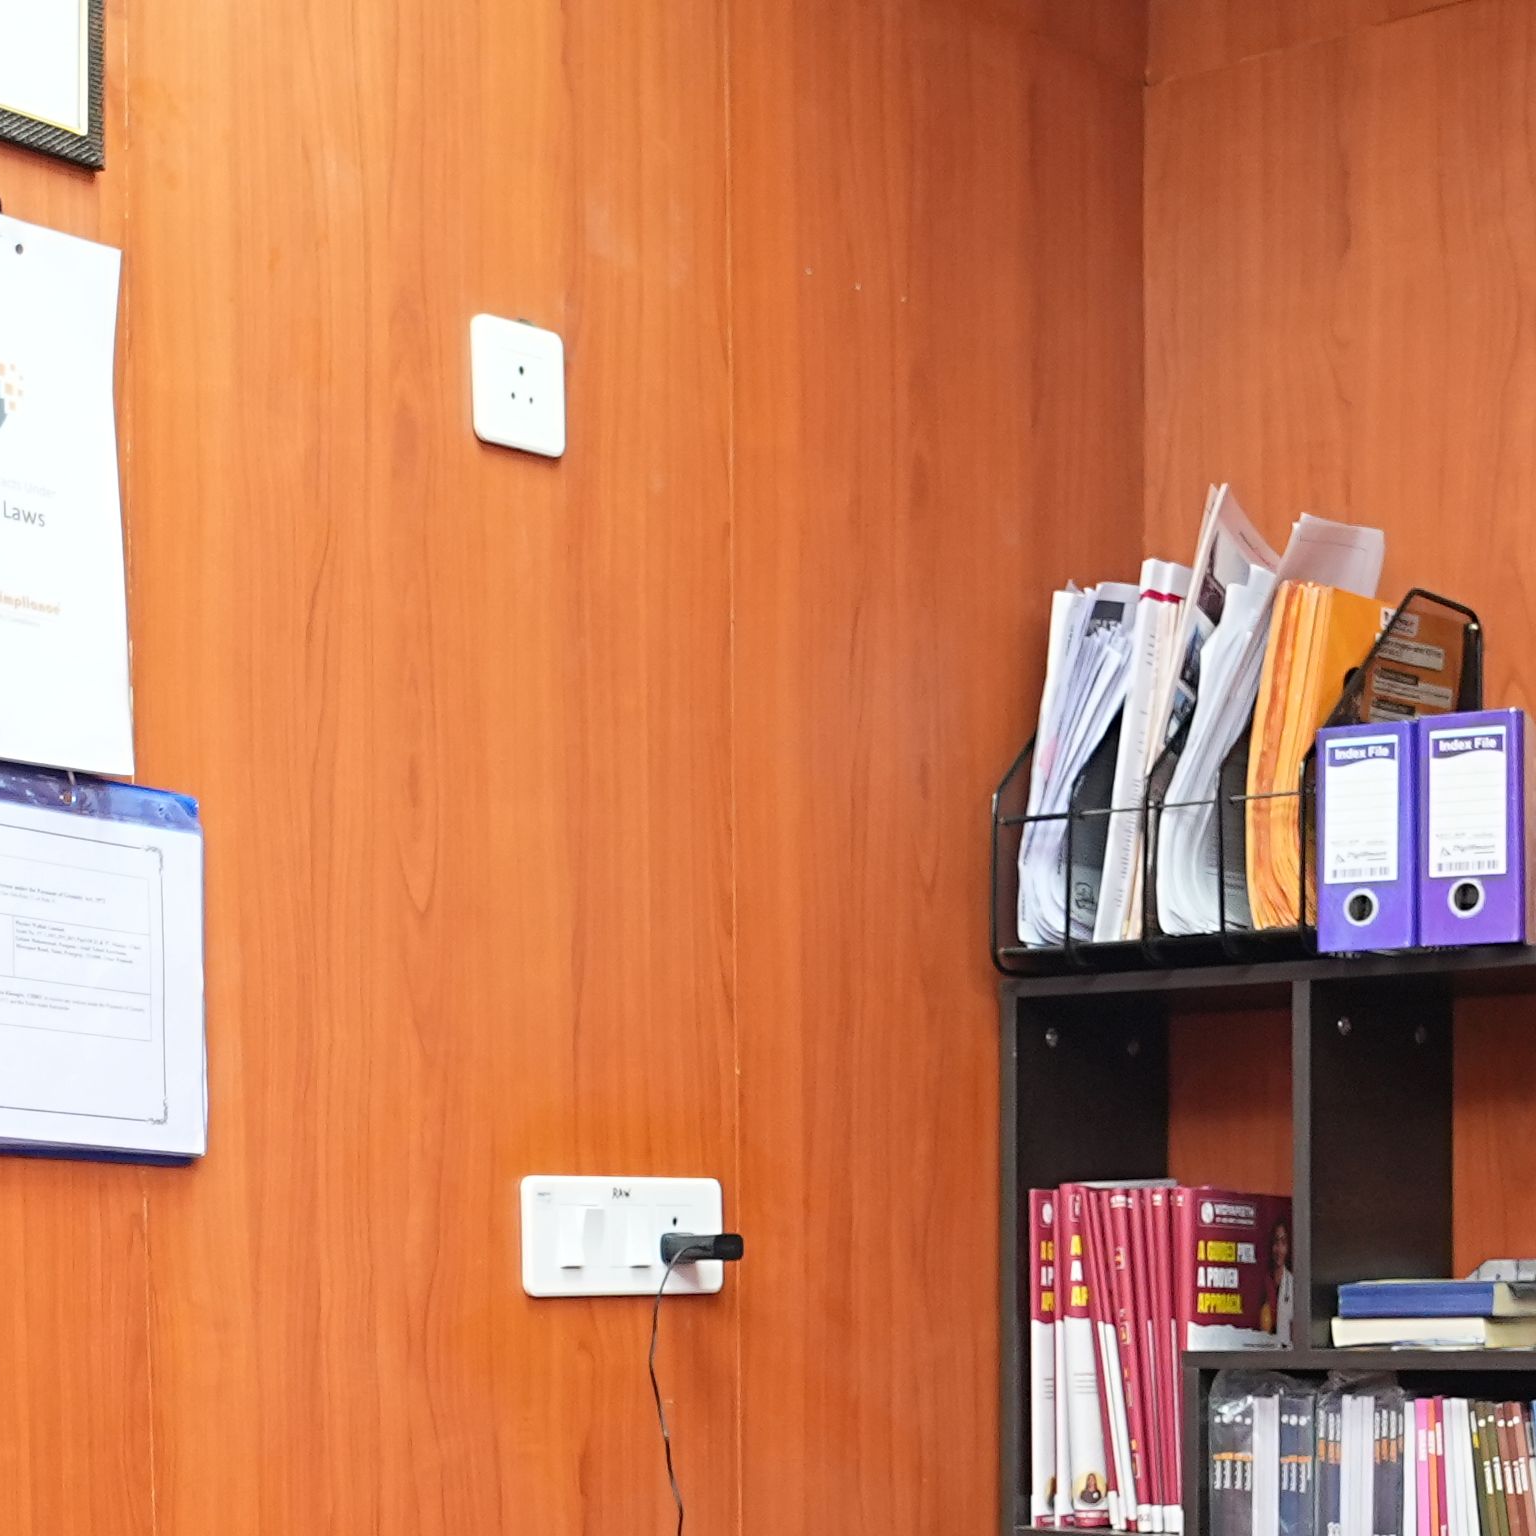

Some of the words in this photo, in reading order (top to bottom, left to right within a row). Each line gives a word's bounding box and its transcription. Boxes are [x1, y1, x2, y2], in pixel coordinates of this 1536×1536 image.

[4, 500, 45, 527] Laws
[1438, 739, 1472, 752] Index
[1474, 736, 1497, 750] File
[1335, 747, 1366, 760] Index
[1368, 745, 1390, 758] File
